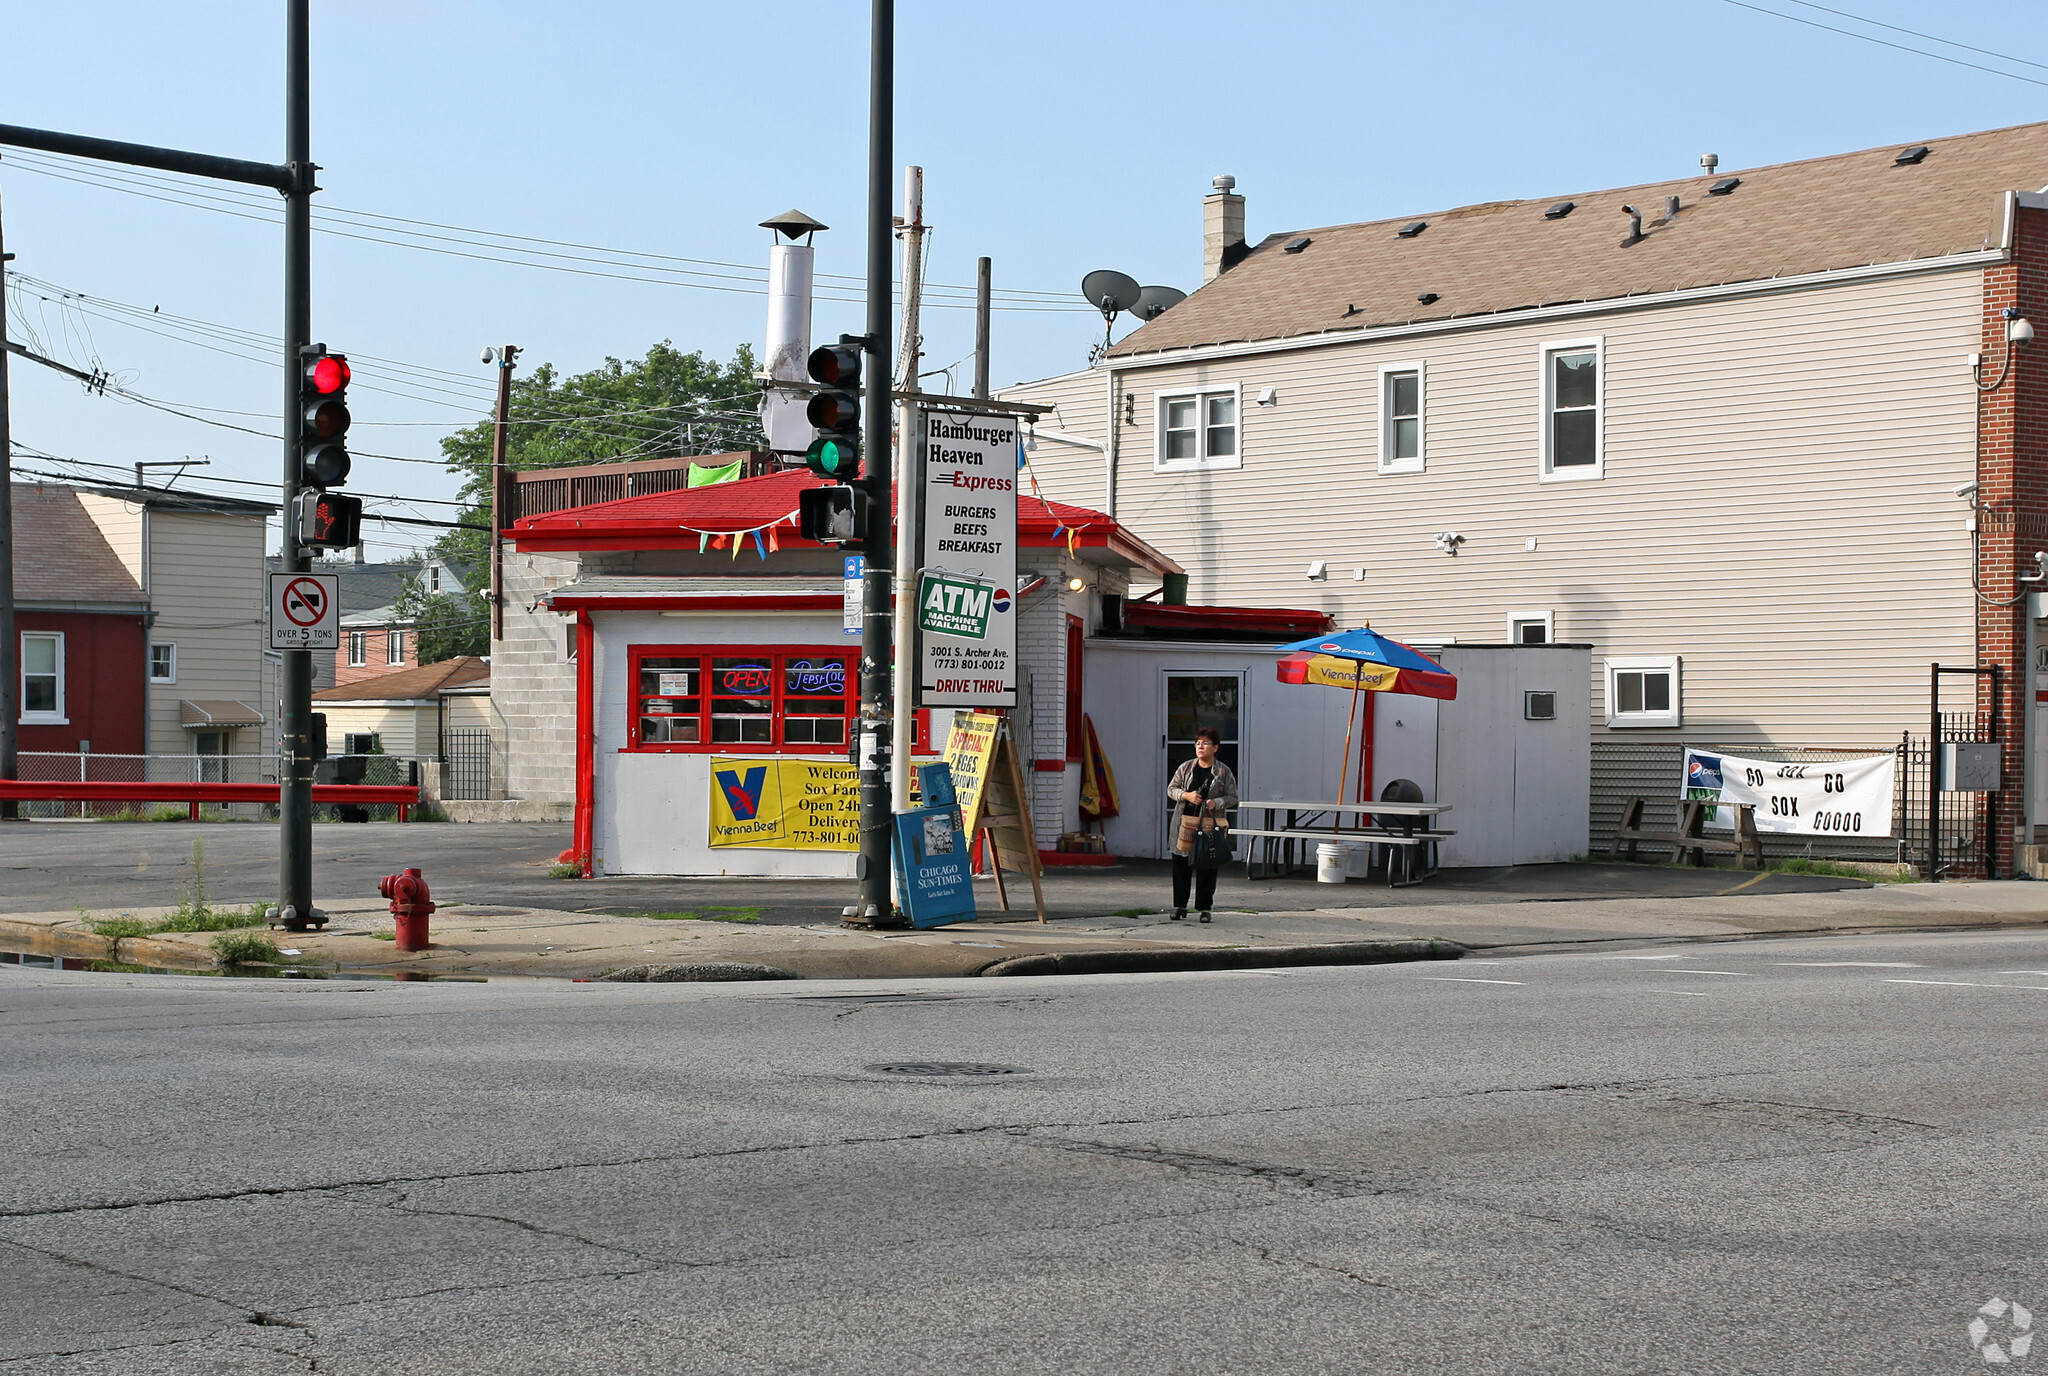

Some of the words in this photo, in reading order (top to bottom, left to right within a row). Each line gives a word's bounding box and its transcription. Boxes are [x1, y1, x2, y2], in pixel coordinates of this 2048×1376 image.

[930, 419, 1014, 447] Hamburger
[929, 444, 984, 466] Heaven
[953, 470, 1012, 492] Express
[944, 505, 997, 520] BURGERS
[953, 523, 988, 536] BEEFS
[938, 539, 1002, 554] BREAKFAST
[924, 583, 989, 619] ATM
[923, 618, 982, 634] AVAILABLE
[928, 611, 979, 626] MACHINE
[277, 630, 297, 639] OVER
[301, 628, 310, 640] 5
[314, 630, 333, 639] TONS
[930, 645, 952, 657] 3001
[954, 646, 963, 657] S.
[965, 647, 991, 658] Archer
[993, 648, 1009, 659] Ave.
[934, 658, 960, 670] (773)
[961, 659, 1005, 670] 801-0012
[722, 670, 771, 689] OPEN
[1320, 667, 1357, 681] Vienna
[1358, 670, 1384, 687] Beef
[936, 678, 971, 693] DRIVE
[973, 679, 1004, 694] THRU
[949, 752, 957, 770] 2
[808, 766, 860, 779] Welcom
[1745, 767, 1764, 787] GO
[1824, 773, 1845, 793] GO
[804, 783, 829, 795] Sox
[799, 798, 833, 814] Open
[837, 799, 860, 812] 24h
[1771, 795, 1800, 817] SOX
[715, 824, 753, 836] Vienna
[753, 819, 778, 833] Beef
[792, 831, 860, 844] 773-801-00
[919, 864, 958, 879] CHICAGO
[917, 874, 963, 889] SUN-TIMES
